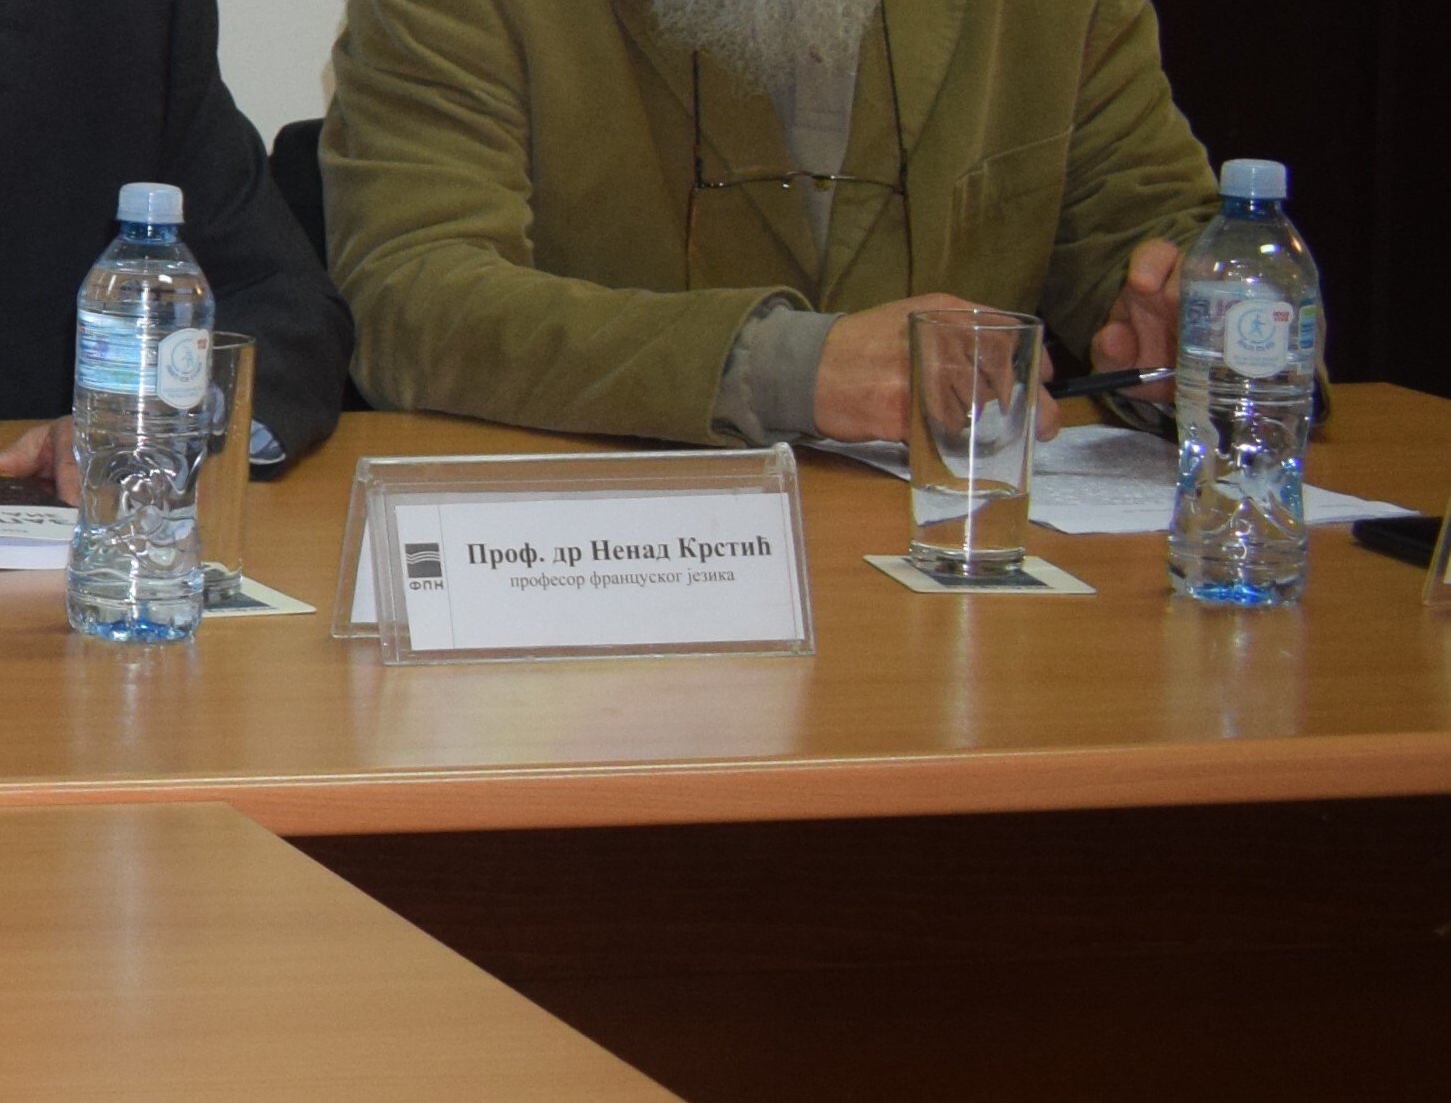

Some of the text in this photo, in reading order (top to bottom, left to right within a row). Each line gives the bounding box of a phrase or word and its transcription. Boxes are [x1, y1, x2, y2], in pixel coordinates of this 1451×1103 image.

[467, 534, 773, 568] Проф. др Ненад Крстић
[408, 578, 445, 591] ФПН
[509, 567, 736, 590] професор француског језика
